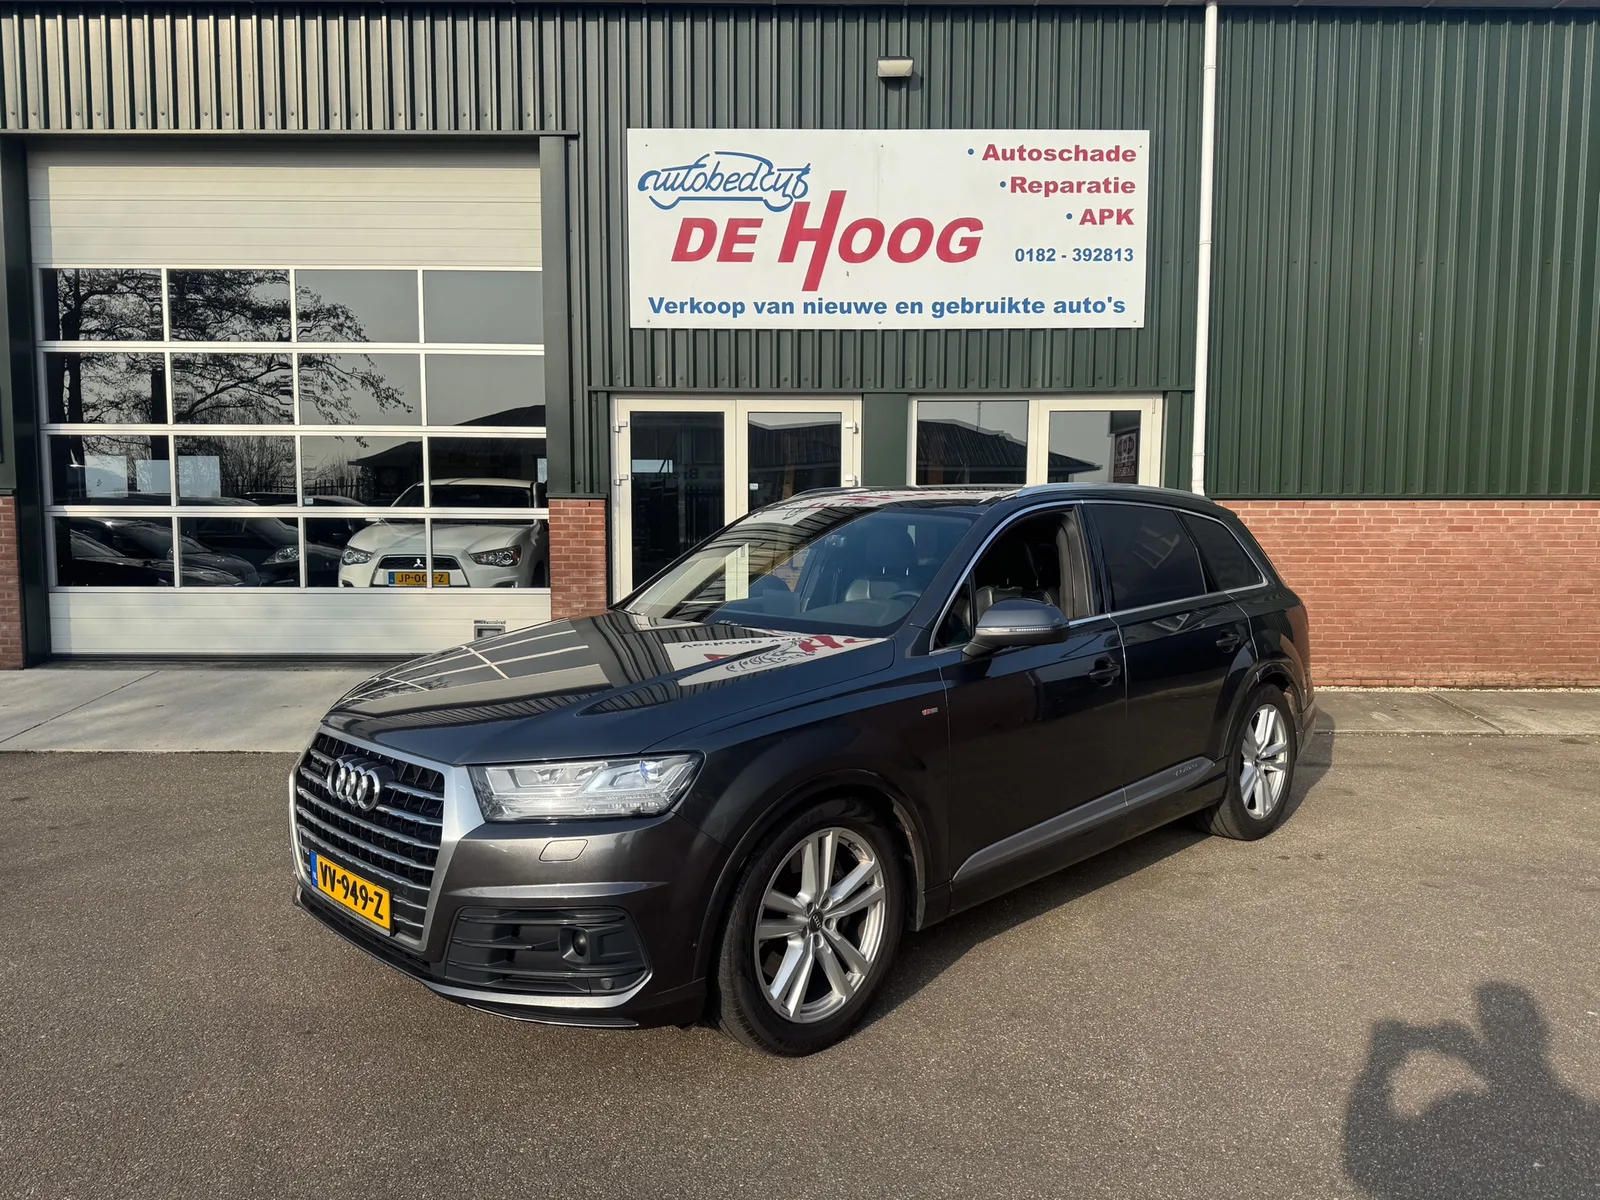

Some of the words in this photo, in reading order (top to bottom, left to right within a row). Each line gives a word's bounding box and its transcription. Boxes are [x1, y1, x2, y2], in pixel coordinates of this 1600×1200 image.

[983, 144, 1137, 163] Autoschade
[1011, 177, 1136, 198] Reparatie
[1080, 209, 1135, 226] APK
[671, 218, 763, 263] DE
[777, 191, 984, 291] HOOG
[1014, 247, 1056, 262] 0182
[1071, 247, 1134, 262] 392813
[648, 298, 745, 318] Verkoop
[754, 302, 795, 315] van
[804, 297, 887, 315] nieuwe
[896, 301, 923, 315] en
[932, 297, 1046, 319] gebruikte
[1053, 296, 1126, 315] auto's
[319, 861, 384, 920] VV-949-Z
